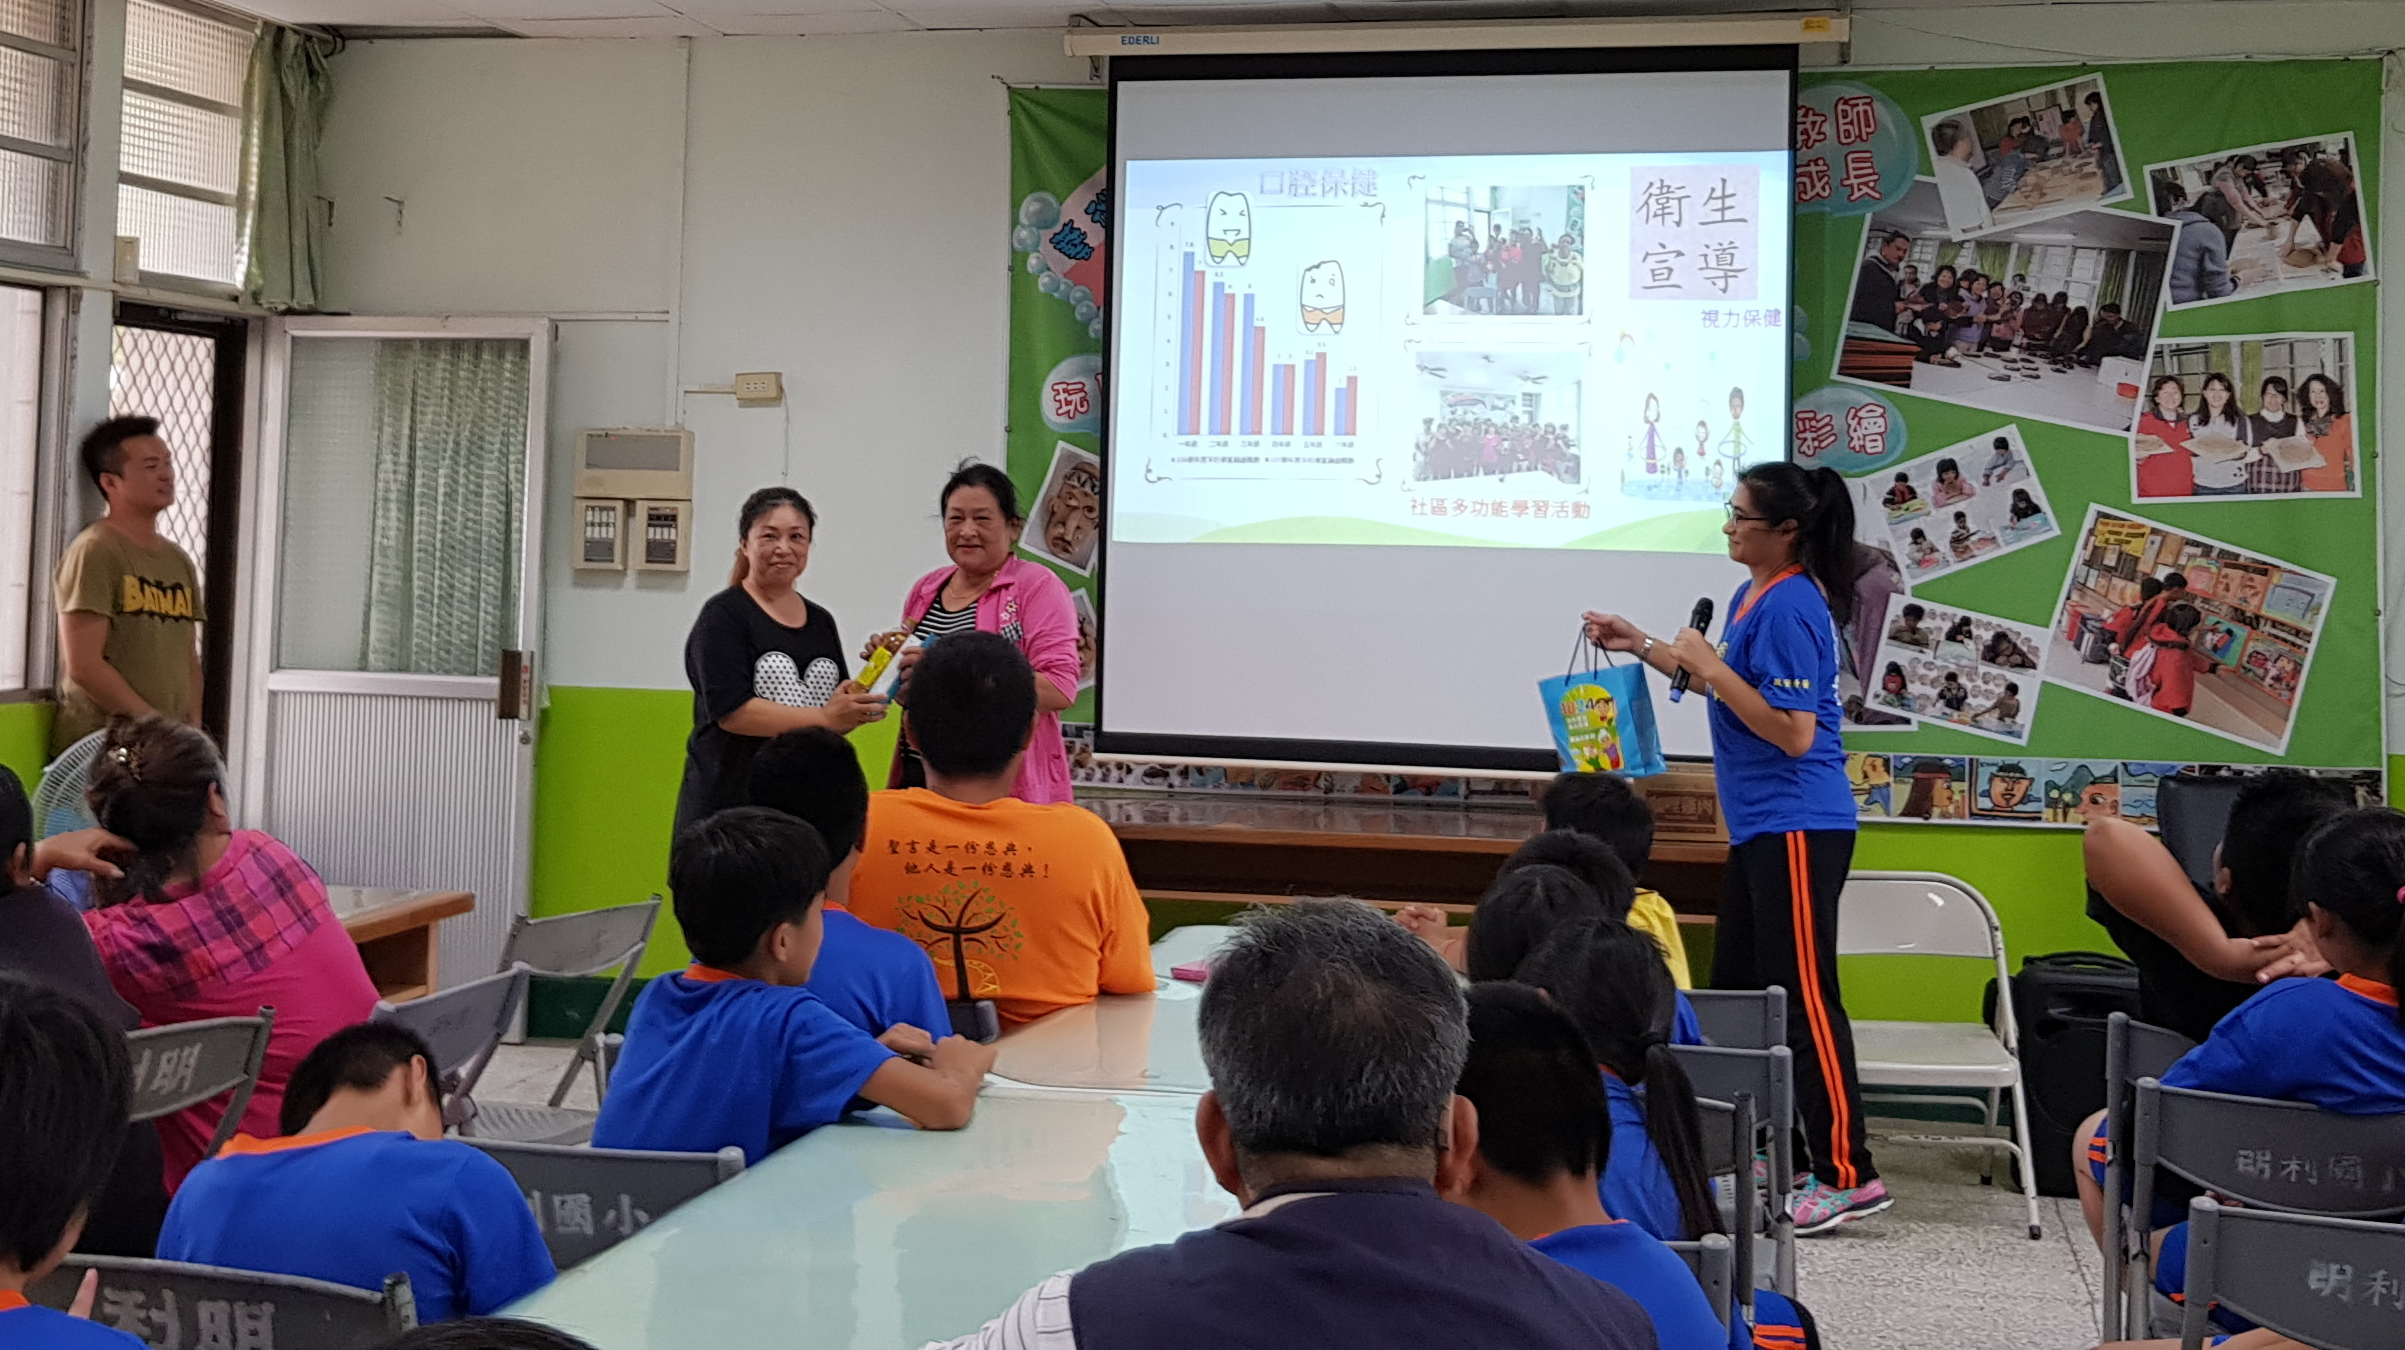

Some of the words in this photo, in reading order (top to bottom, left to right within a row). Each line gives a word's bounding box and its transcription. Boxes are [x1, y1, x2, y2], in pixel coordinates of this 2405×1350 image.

[1259, 168, 1379, 198] 口腔保健
[1636, 178, 1748, 228] 衛生
[1641, 241, 1749, 295] 宣導
[1700, 308, 1783, 329] 視力保健
[1796, 403, 1887, 457] 彩繪
[1410, 497, 1591, 519] 社區多功能學習活動
